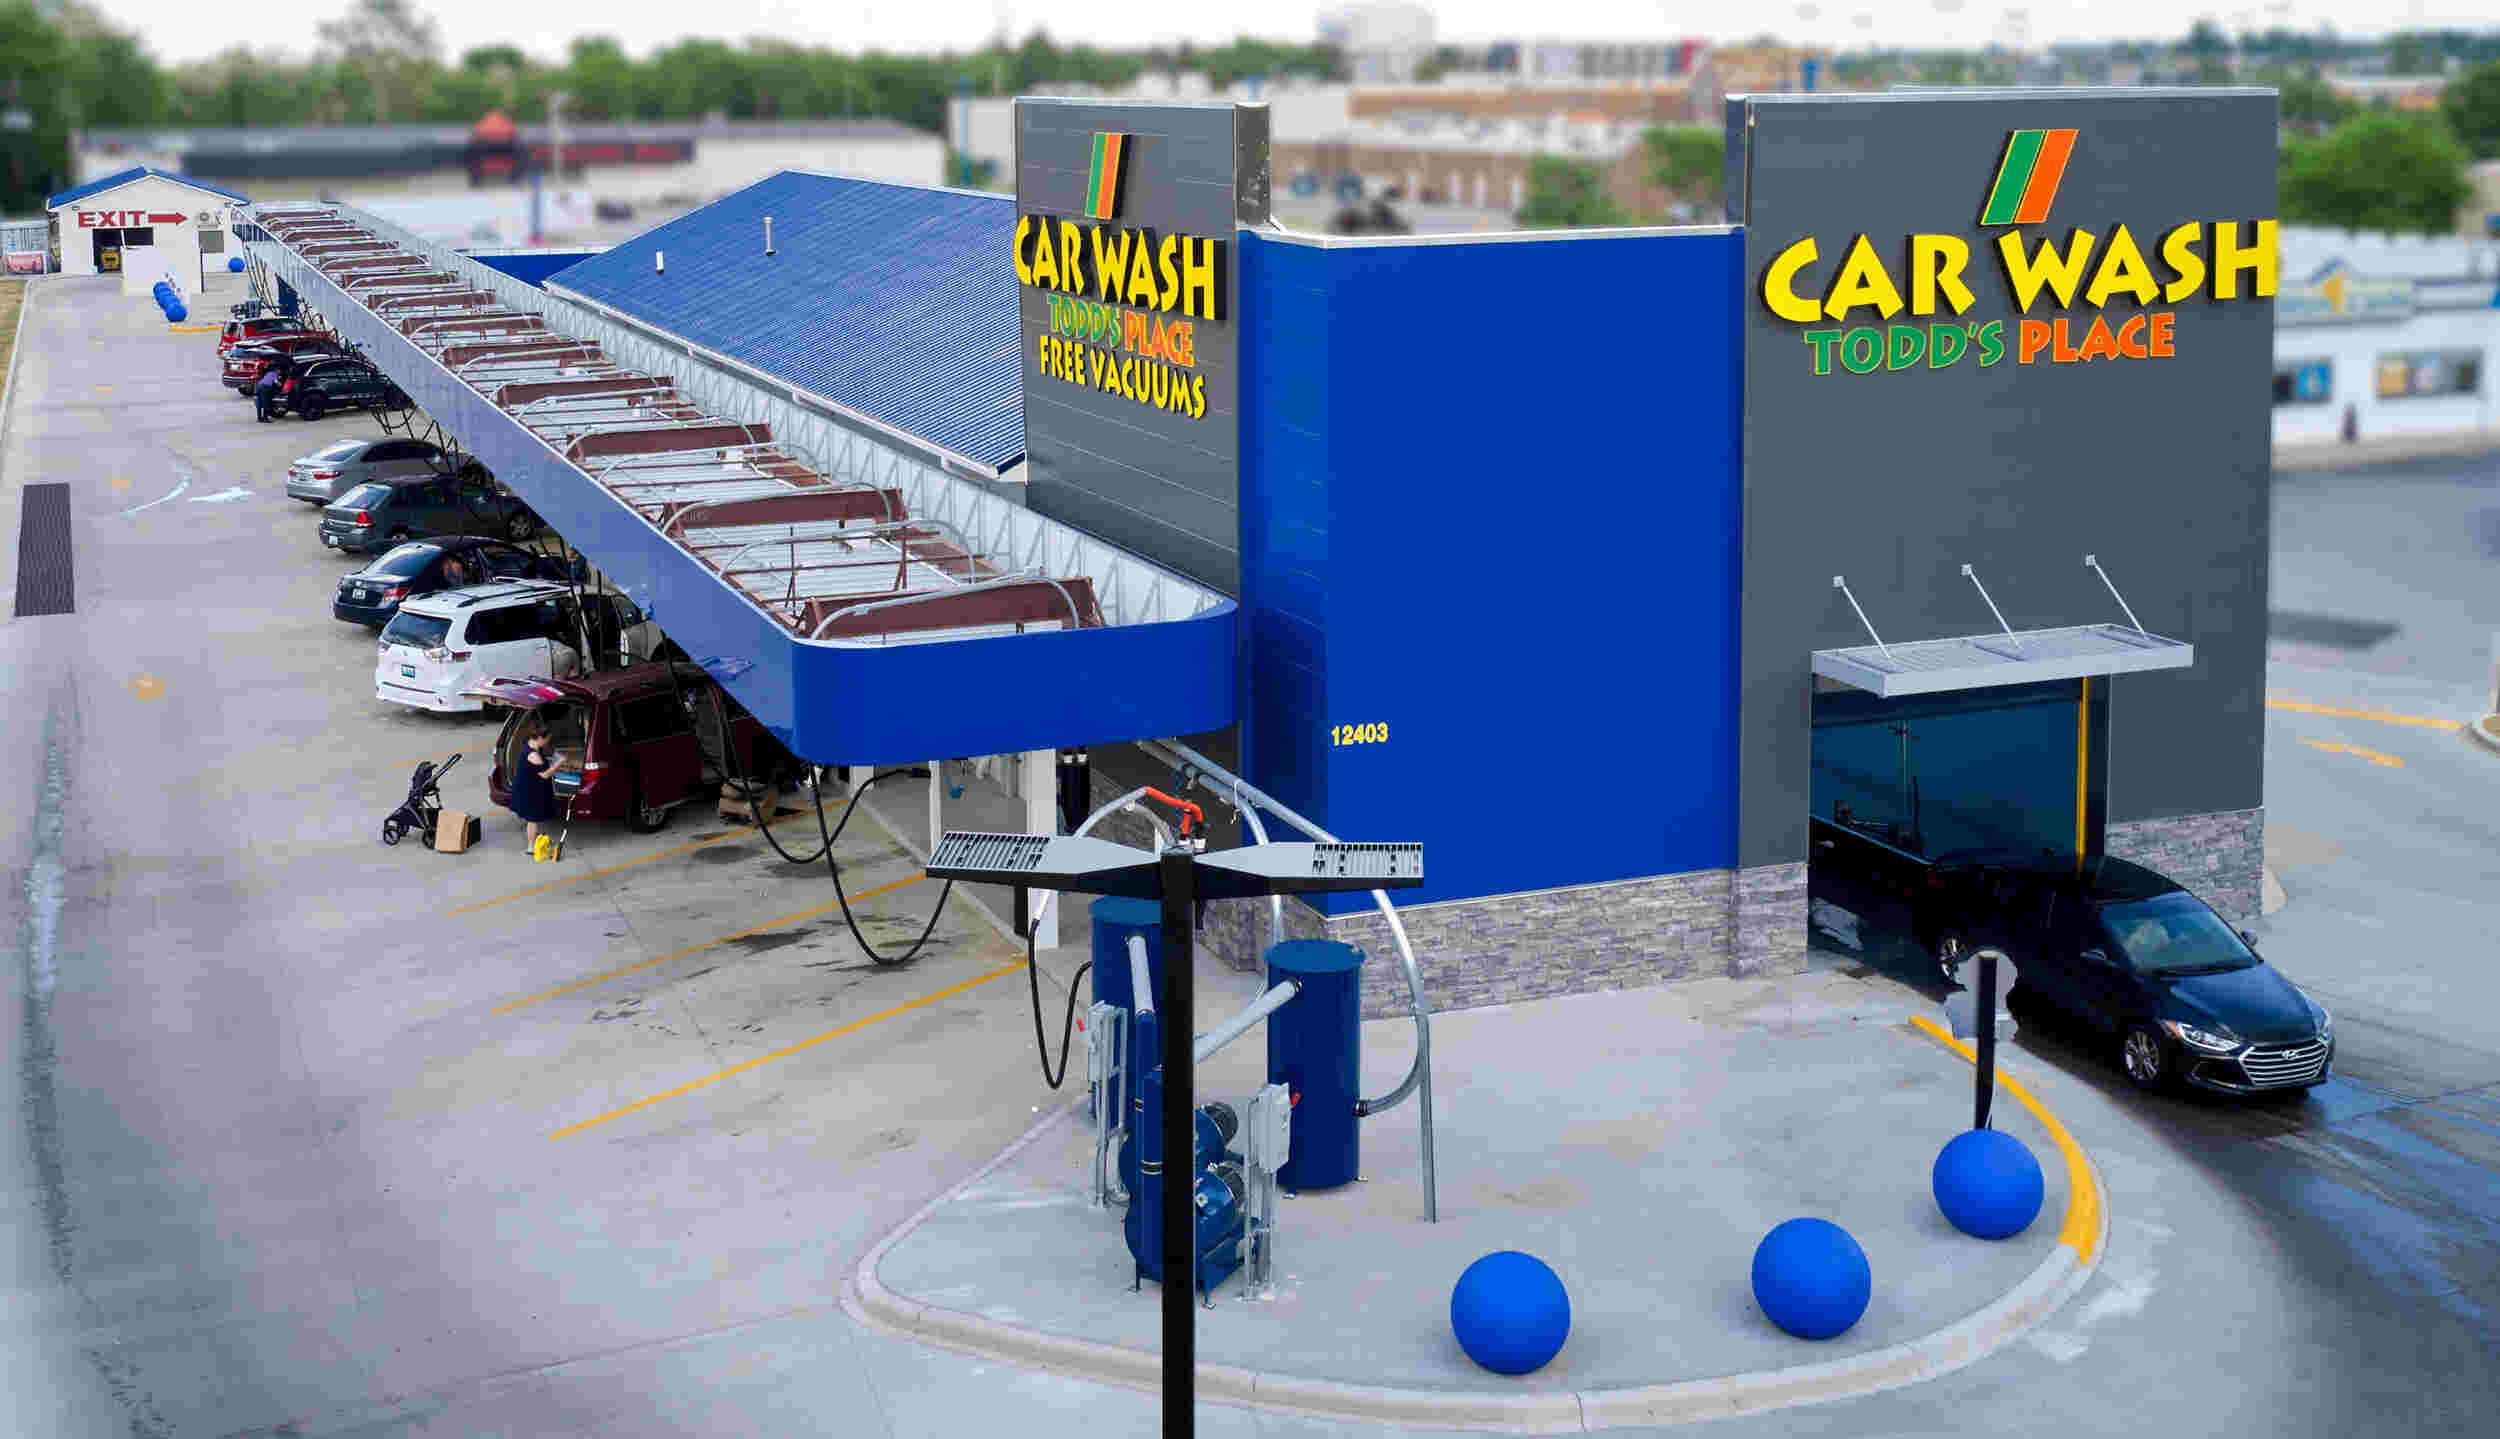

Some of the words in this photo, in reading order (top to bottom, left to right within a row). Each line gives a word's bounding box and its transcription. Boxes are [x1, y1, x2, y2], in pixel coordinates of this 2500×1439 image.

[78, 210, 146, 228] EXIT
[1013, 215, 1085, 295] CAR
[1091, 225, 1215, 320] WASH
[1764, 233, 1976, 322] CAR
[1999, 219, 2278, 314] WASH
[1047, 294, 1122, 348] TODD'S
[1124, 310, 1195, 367] PLACE
[1804, 320, 2003, 375] TODD'S
[2018, 312, 2176, 364] PLACE
[1040, 335, 1086, 385] FREE
[1090, 349, 1206, 418] VACUUMS
[1331, 722, 1388, 746] 12403
